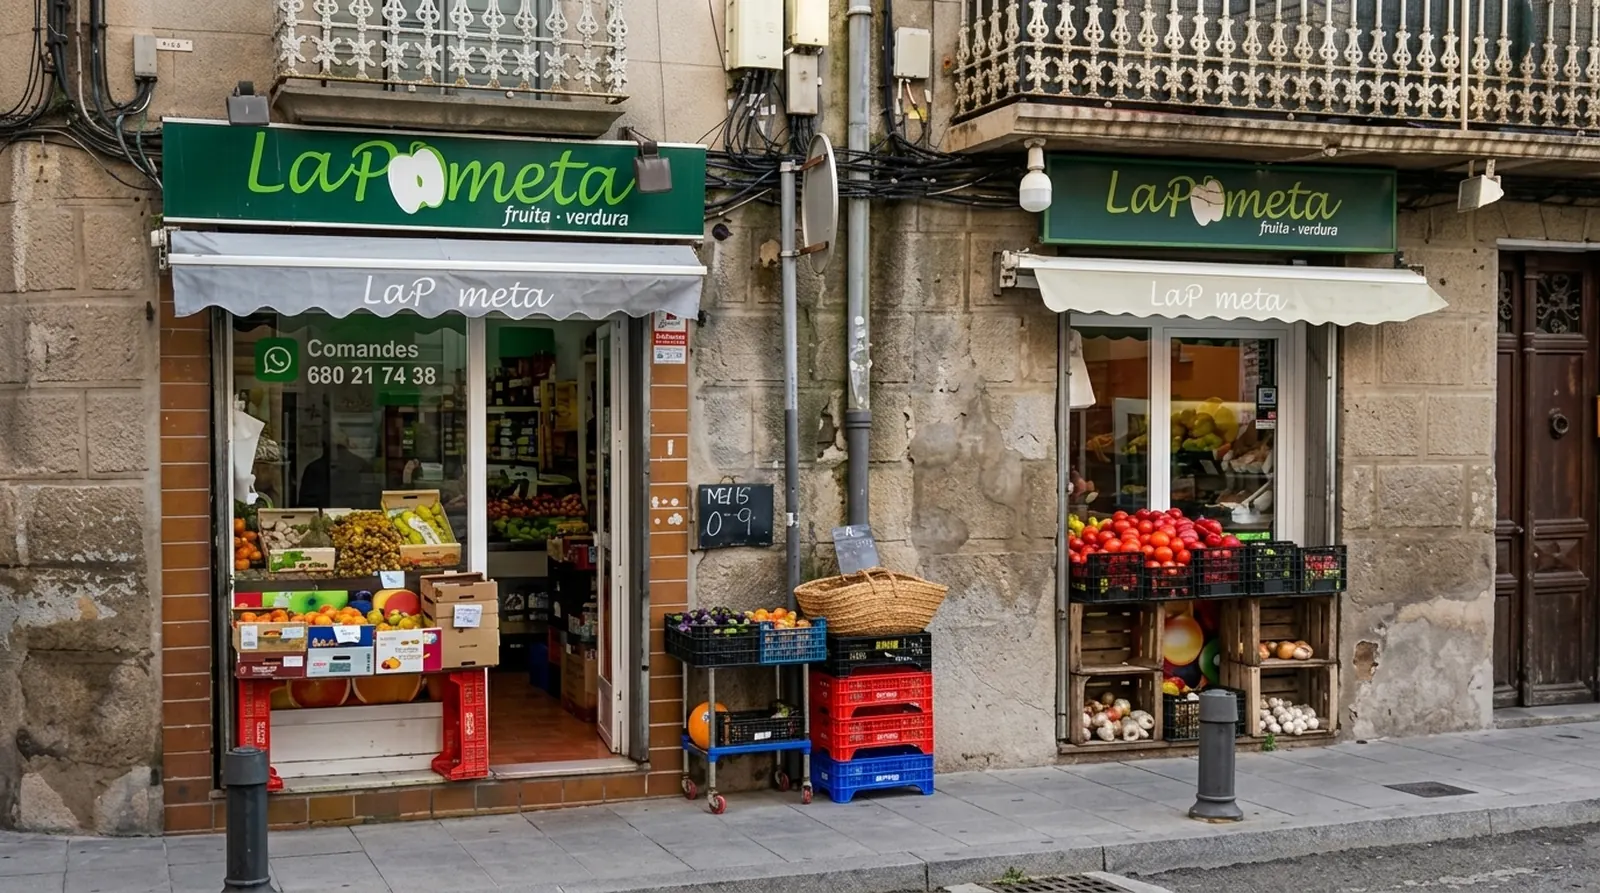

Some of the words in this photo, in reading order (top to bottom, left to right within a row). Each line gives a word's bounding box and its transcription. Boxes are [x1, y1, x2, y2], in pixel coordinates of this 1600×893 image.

[502, 205, 550, 227] fruita
[565, 208, 629, 226] verdura
[1259, 220, 1290, 236] fruita
[1298, 222, 1338, 236] verdura
[307, 339, 419, 358] Comandes
[307, 365, 344, 385] 680
[351, 366, 373, 384] 21
[382, 366, 406, 384] 74
[412, 367, 436, 385] 38
